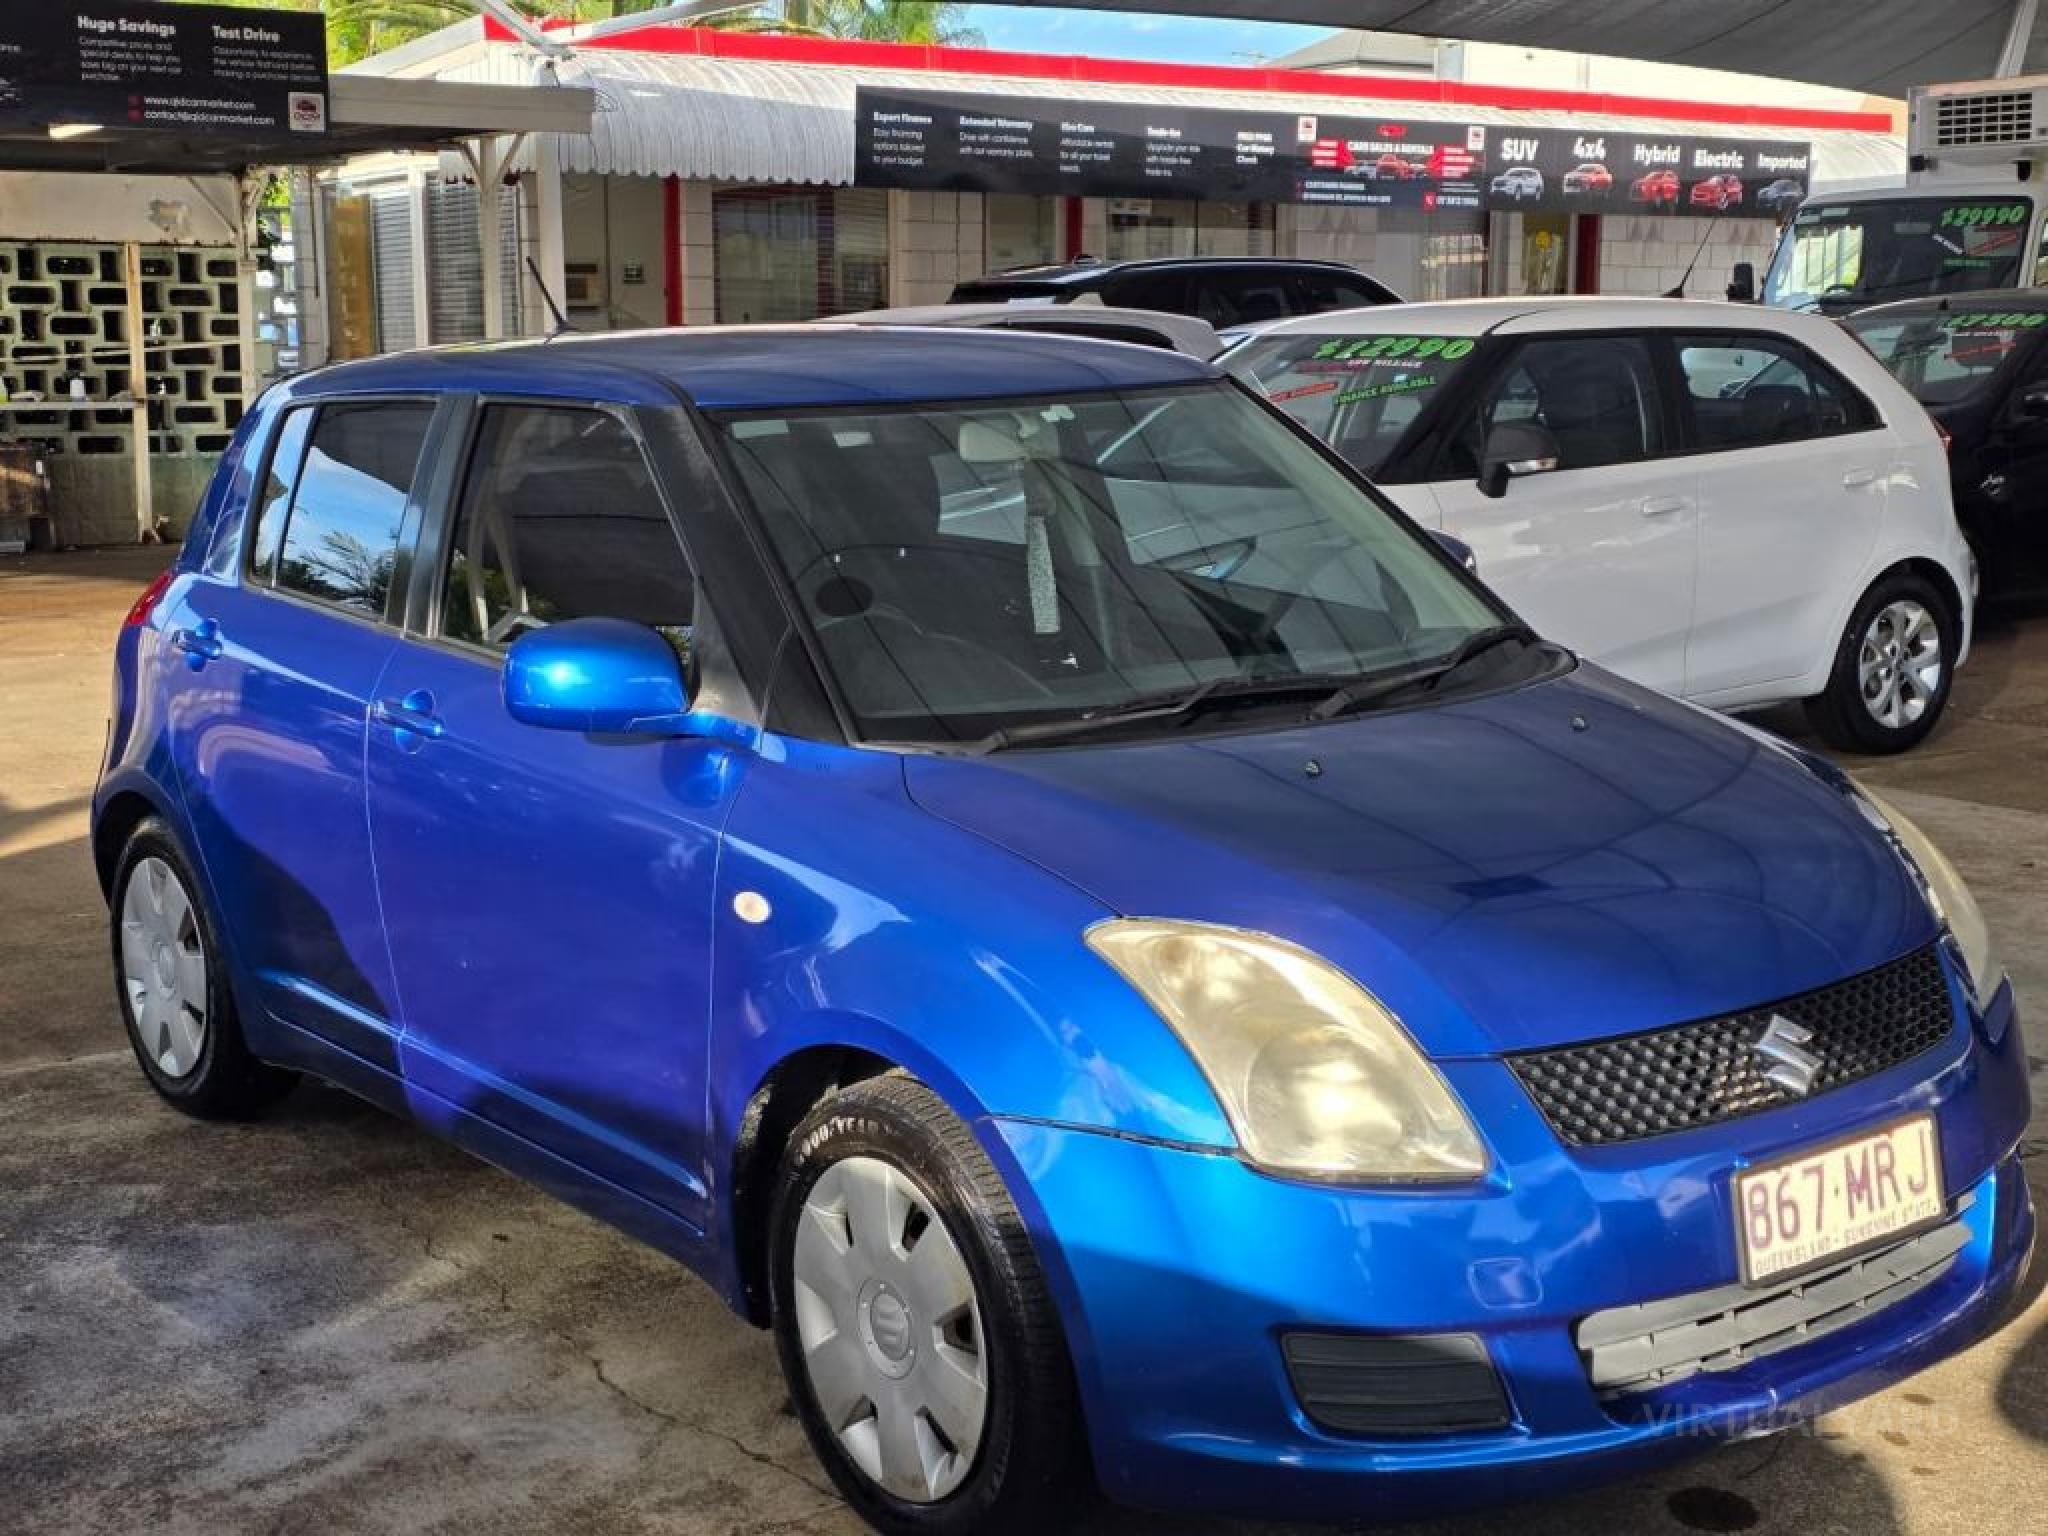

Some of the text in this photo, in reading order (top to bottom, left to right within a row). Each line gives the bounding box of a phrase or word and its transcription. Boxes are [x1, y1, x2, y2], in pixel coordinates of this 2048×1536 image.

[78, 15, 176, 37] Huge Savings
[212, 25, 280, 43] Test Drive
[143, 95, 256, 111] www.qldcarmarket.com
[959, 115, 997, 129] Extended
[1502, 137, 1539, 161] SUV
[1573, 135, 1606, 160] 4x4
[1634, 143, 1680, 166] Hybrid
[1694, 148, 1745, 170] Electric
[1757, 153, 1807, 172] Imported
